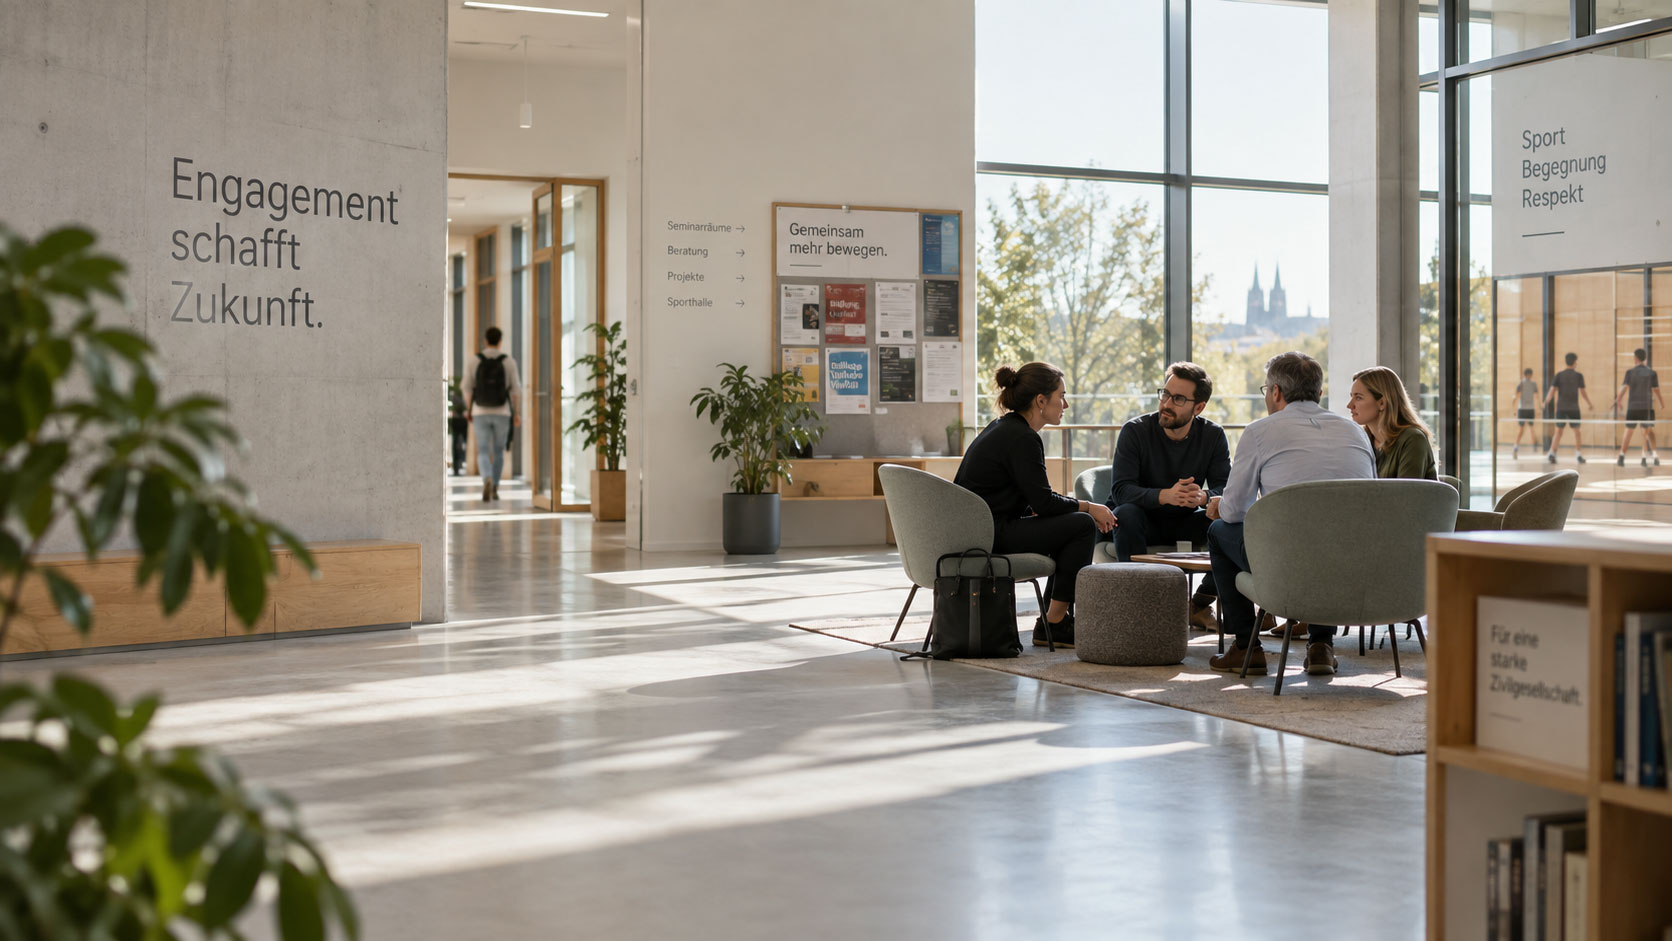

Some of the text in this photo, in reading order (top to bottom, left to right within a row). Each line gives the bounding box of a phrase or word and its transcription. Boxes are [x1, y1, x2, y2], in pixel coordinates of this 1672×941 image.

[1522, 127, 1566, 153] Sport
[1522, 154, 1607, 182] Begegnung
[172, 156, 399, 226] Engagement
[1522, 183, 1584, 211] Respekt
[667, 220, 732, 233] Seminarräume
[789, 222, 864, 238] Gemeinsam
[171, 222, 301, 271] schafft
[667, 245, 709, 258] Beratung
[789, 241, 888, 259] mehr bewegen.
[667, 271, 705, 283] Projekte
[170, 280, 323, 328] Zukunft.
[667, 296, 713, 308] Sporthalle
[1491, 624, 1539, 649] Für eine
[1491, 652, 1528, 672] starke
